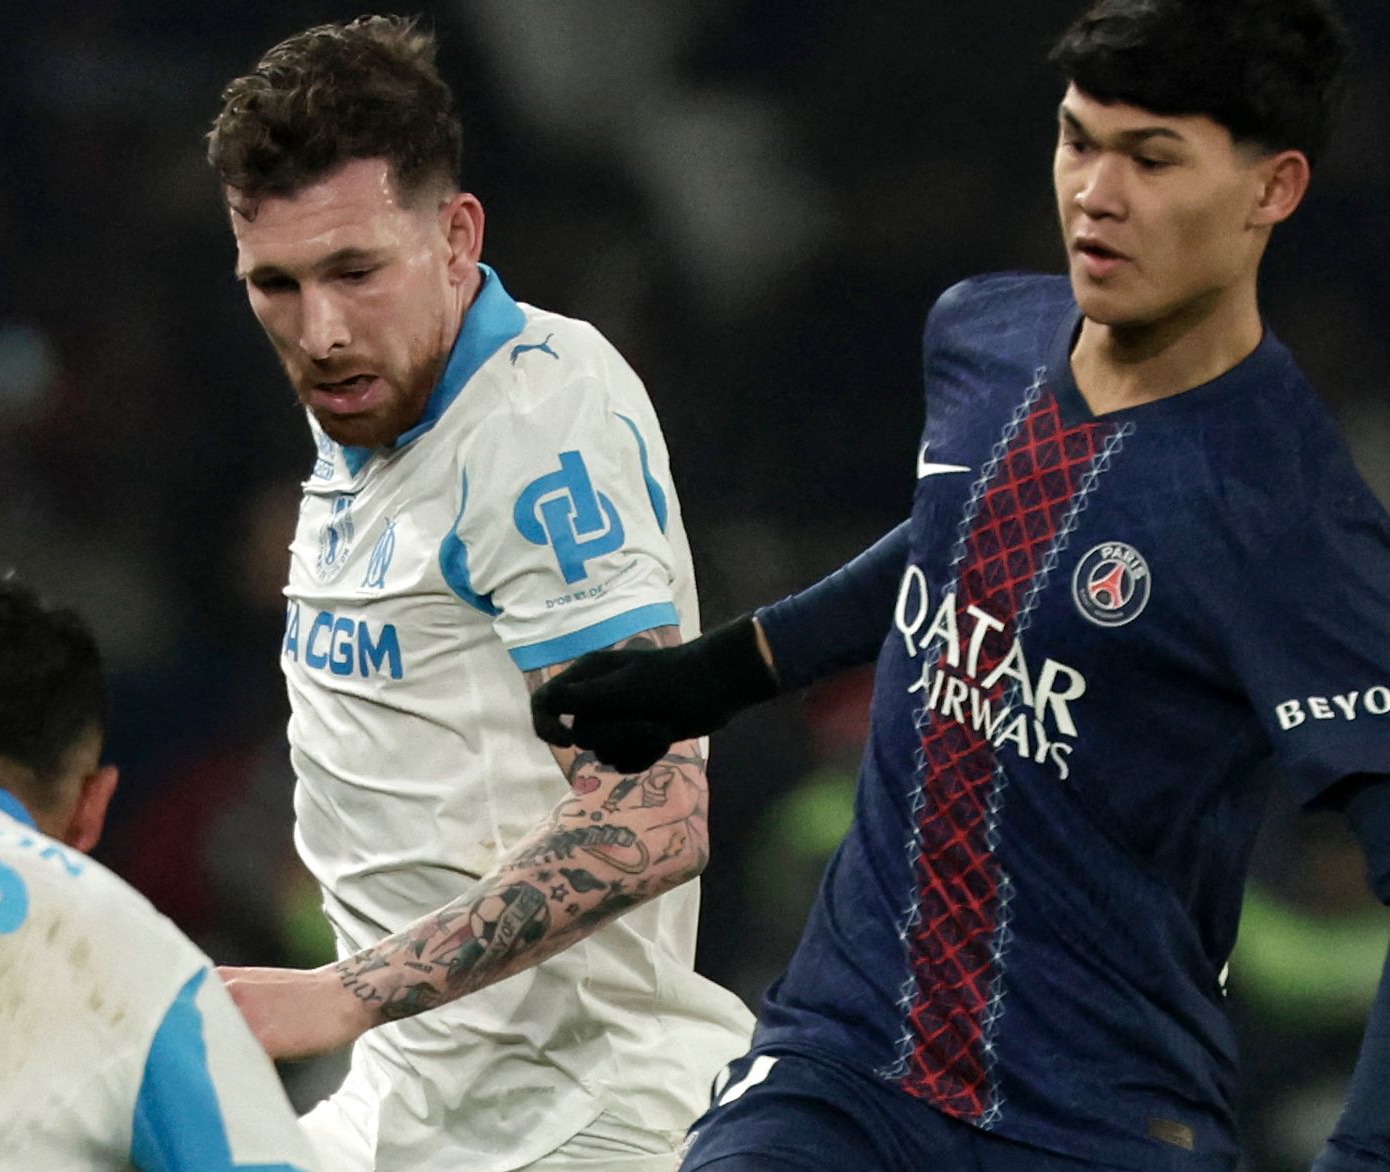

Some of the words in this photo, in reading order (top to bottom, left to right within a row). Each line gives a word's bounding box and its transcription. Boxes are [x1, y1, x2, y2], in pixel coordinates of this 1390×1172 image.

[1100, 546, 1147, 581] PARIS
[305, 610, 404, 680] CGM
[895, 563, 1087, 738] QATAR
[907, 661, 1074, 780] AIRWAYS
